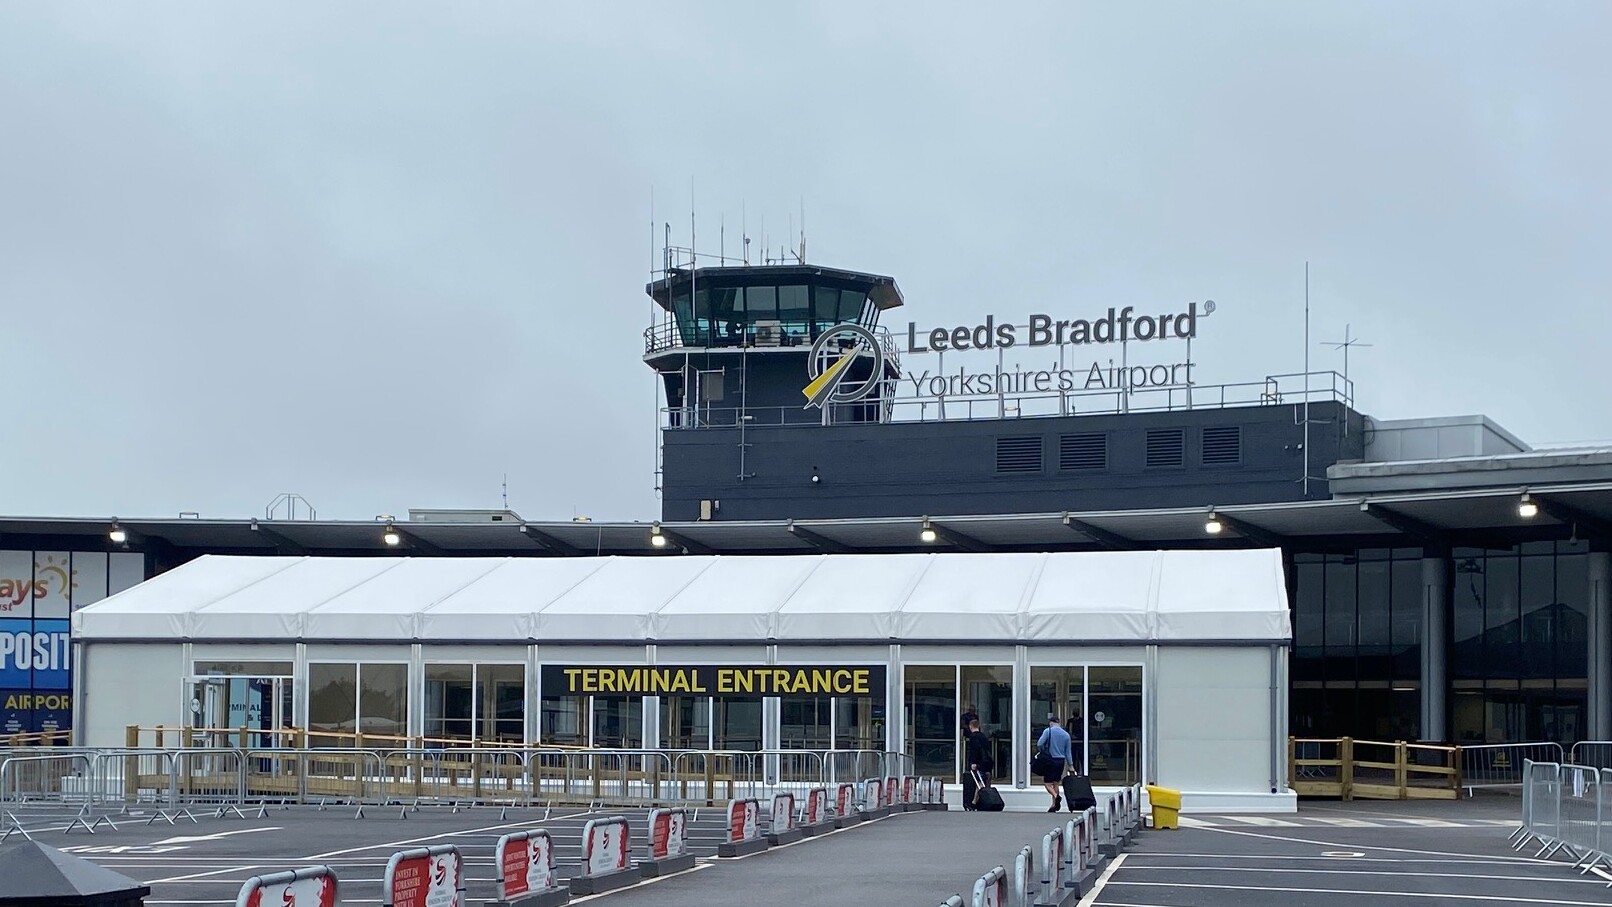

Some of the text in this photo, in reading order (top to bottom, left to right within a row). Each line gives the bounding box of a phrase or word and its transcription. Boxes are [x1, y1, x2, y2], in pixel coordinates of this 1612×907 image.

[907, 302, 1197, 354] Leeds Bradford
[1083, 358, 1197, 395] Airport
[563, 668, 870, 694] TERMINAL ENTRANCE
[4, 694, 72, 711] AIRPOR
